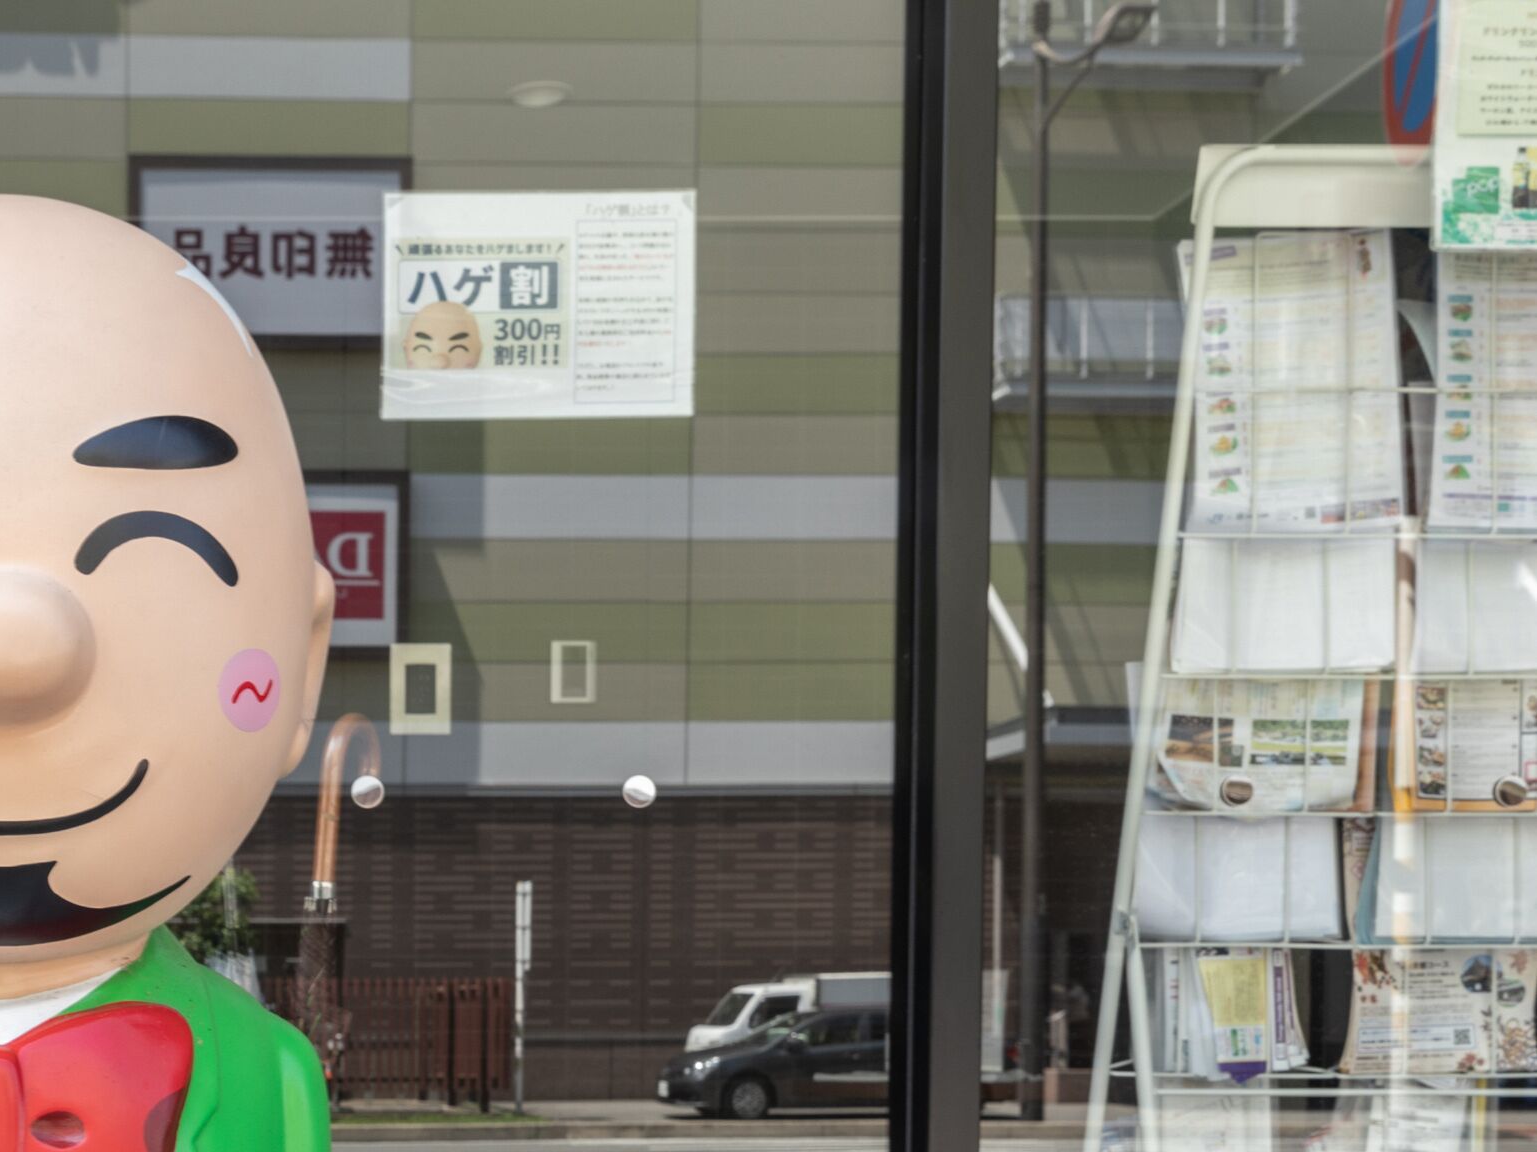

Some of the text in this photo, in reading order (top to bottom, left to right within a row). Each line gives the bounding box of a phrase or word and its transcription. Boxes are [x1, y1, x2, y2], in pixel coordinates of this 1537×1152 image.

[407, 264, 551, 307] ハゲ割
[493, 318, 561, 342] 300円
